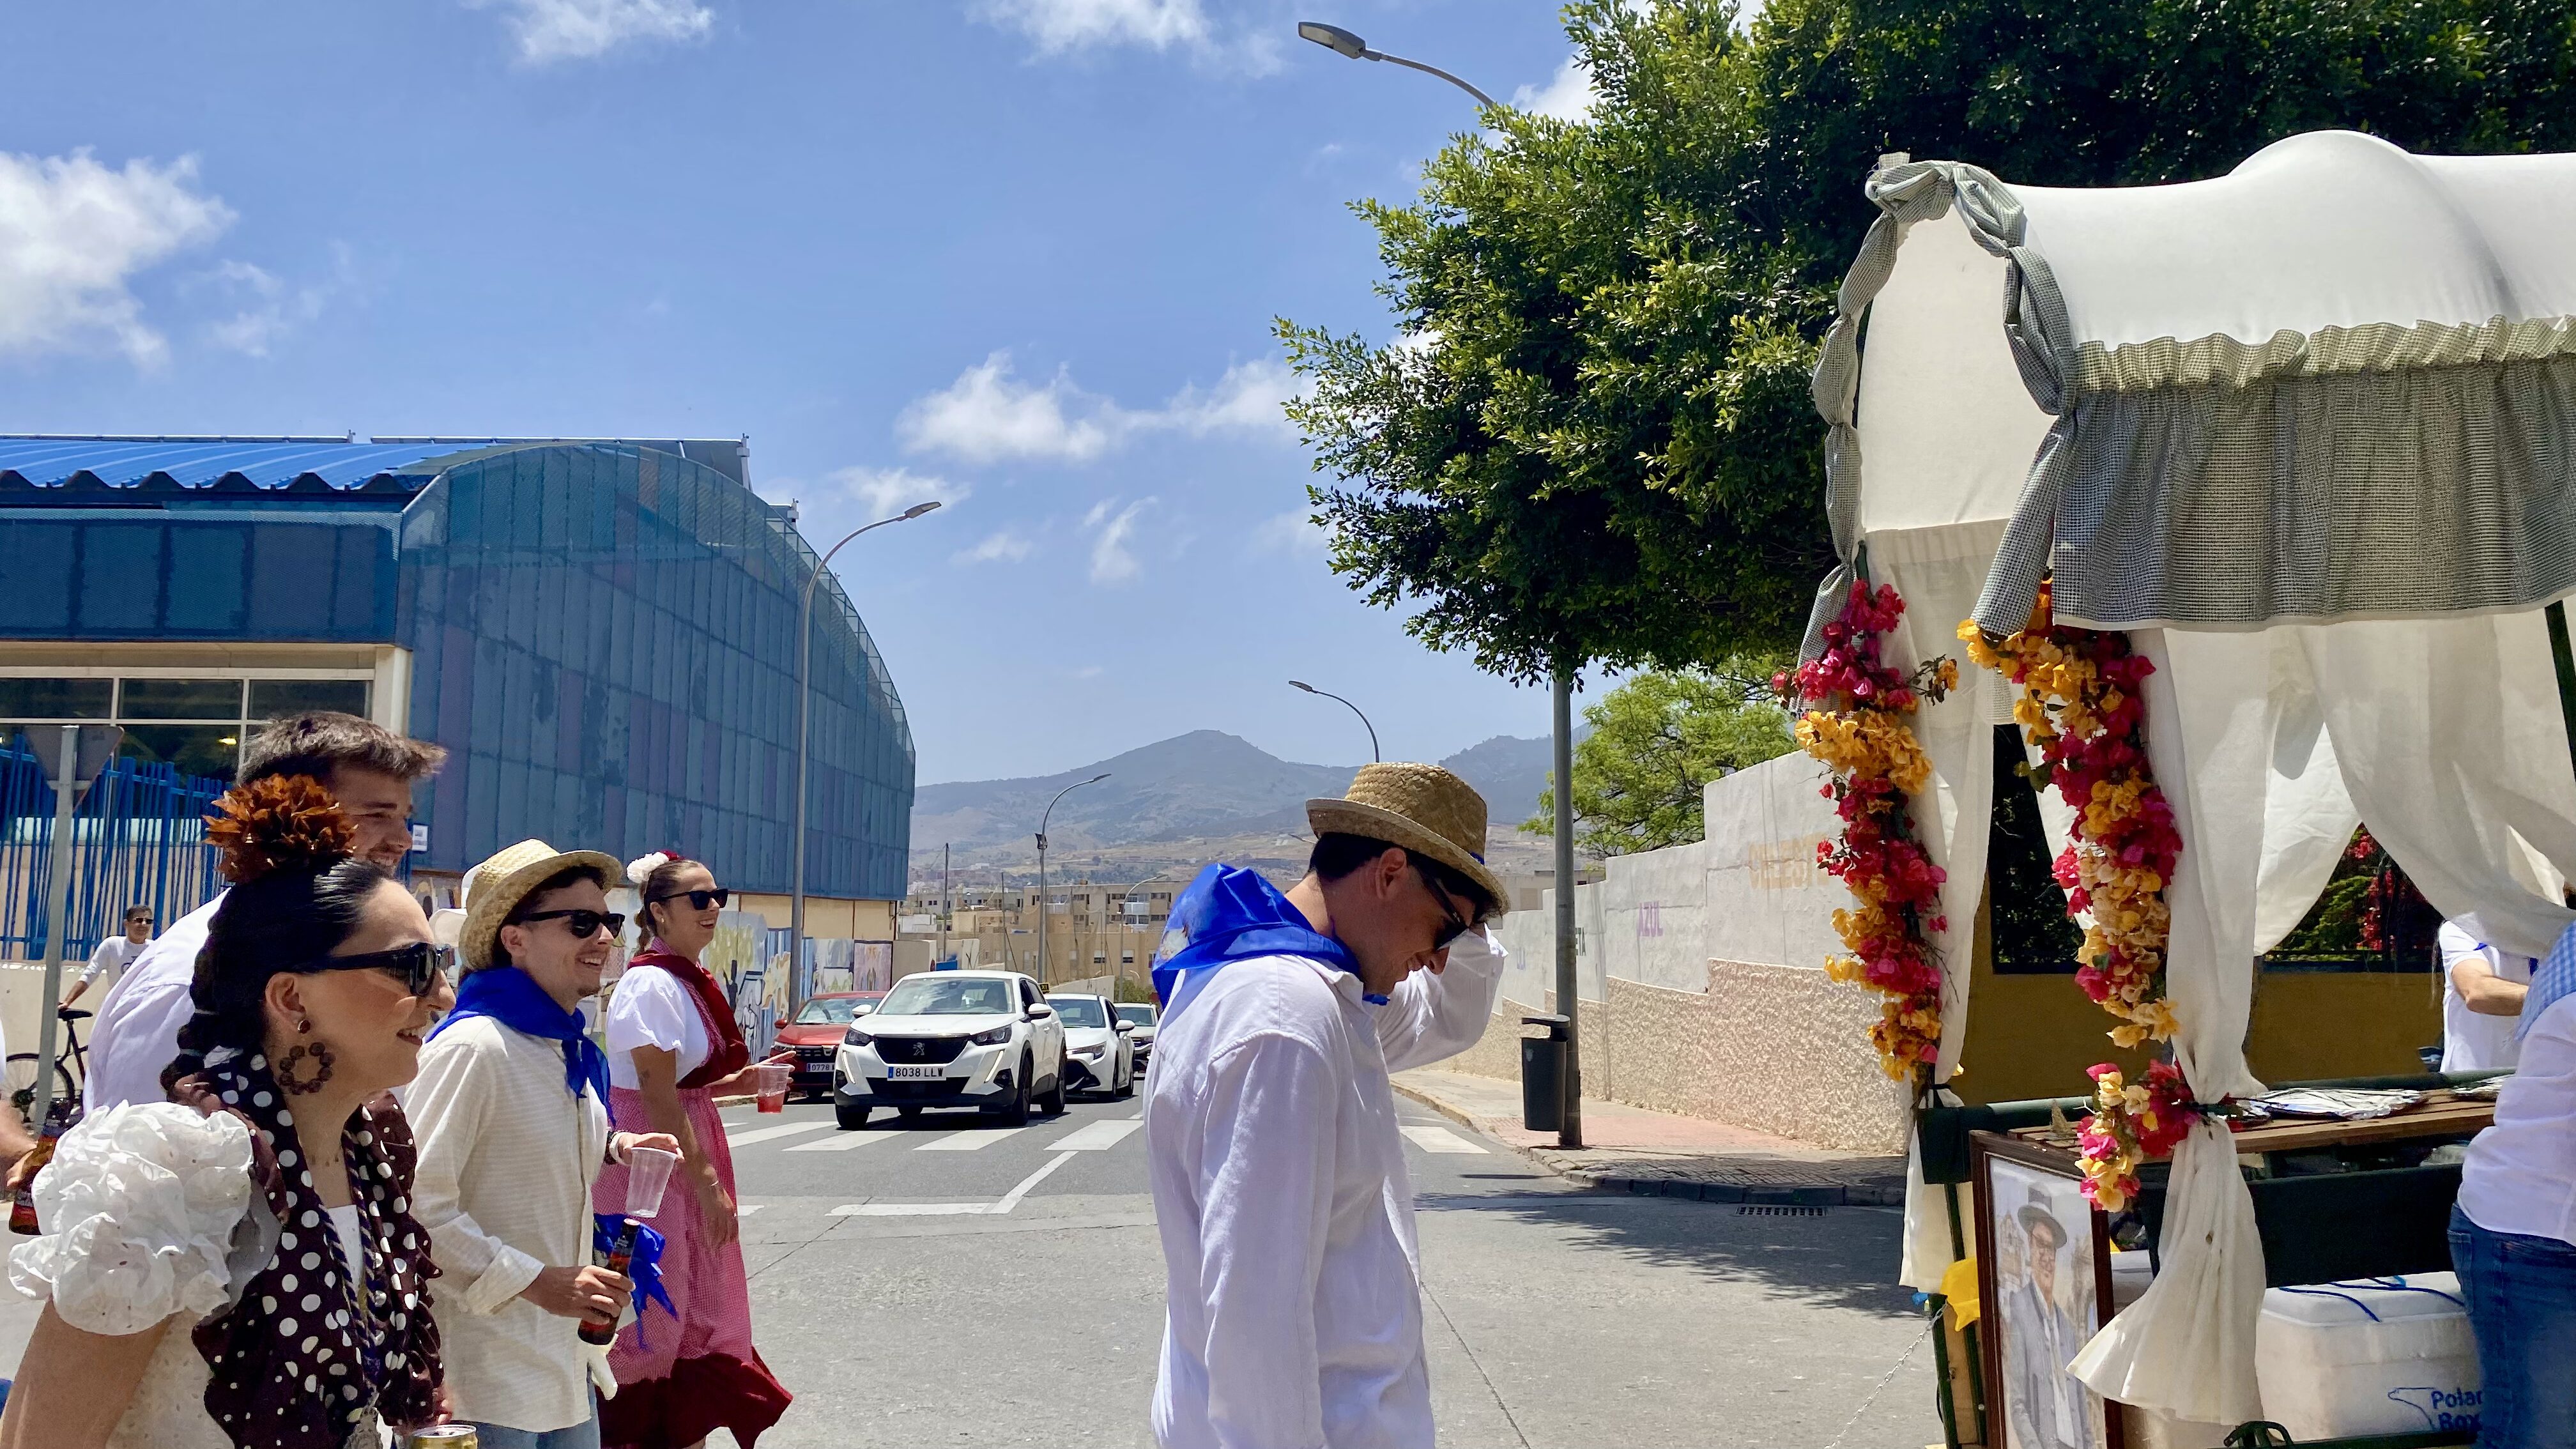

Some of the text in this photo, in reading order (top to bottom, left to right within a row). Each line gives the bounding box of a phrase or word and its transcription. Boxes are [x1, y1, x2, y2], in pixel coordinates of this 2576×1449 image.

[1637, 901, 1663, 937] AZUL
[895, 1068, 921, 1077] 8038
[2430, 1386, 2483, 1409] Polar
